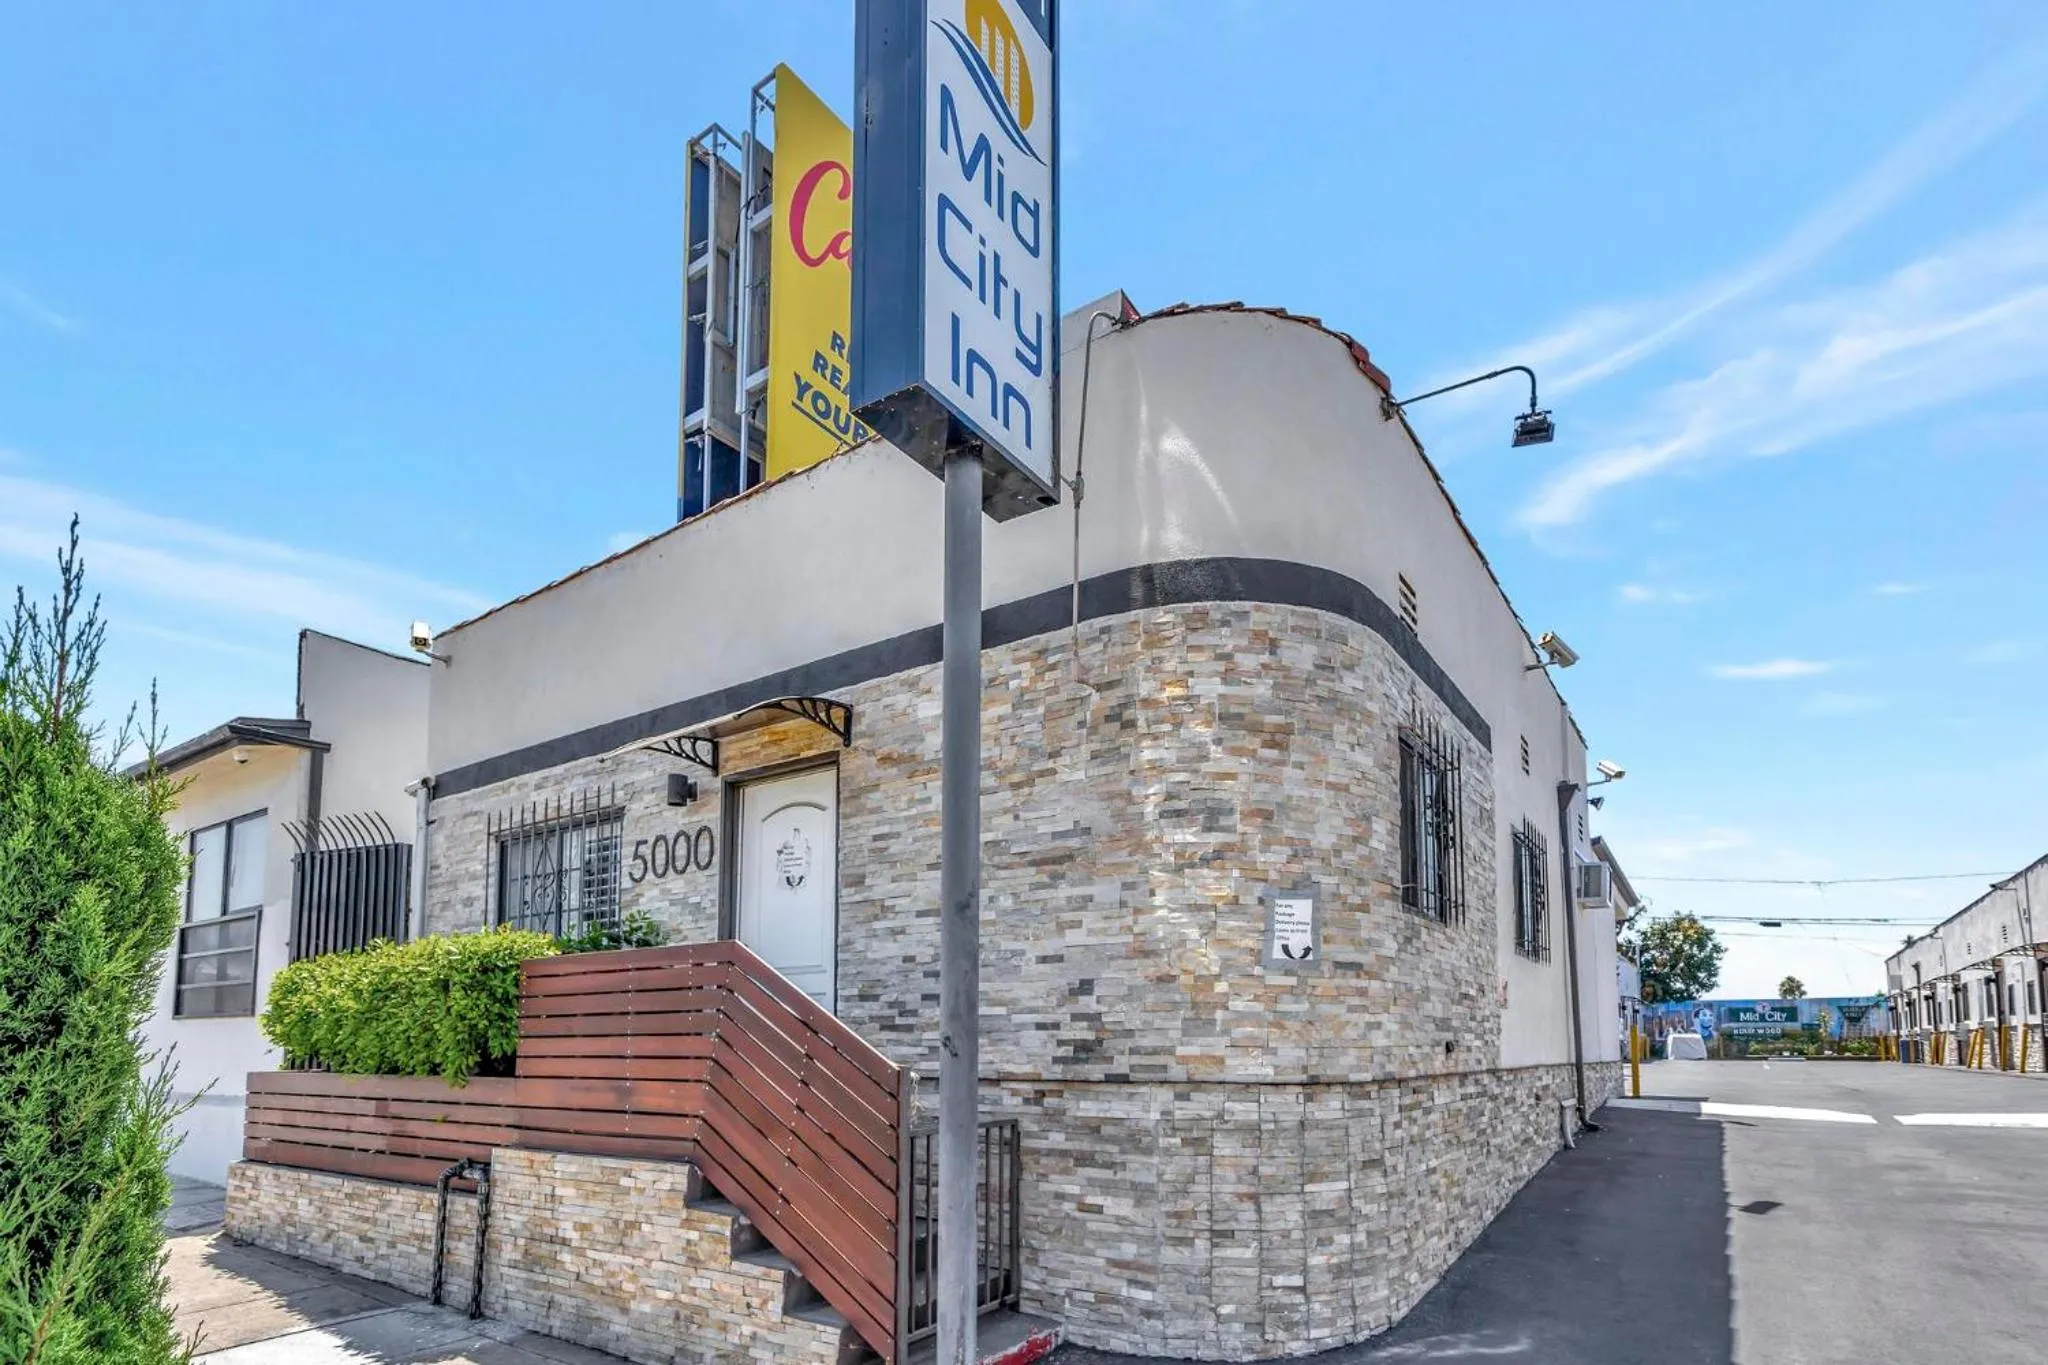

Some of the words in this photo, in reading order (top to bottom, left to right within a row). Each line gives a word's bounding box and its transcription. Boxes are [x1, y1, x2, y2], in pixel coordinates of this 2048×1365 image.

[940, 83, 1040, 258] Mid
[937, 193, 1042, 377] City
[951, 311, 1032, 450] Inn
[628, 825, 714, 883] 5000
[1765, 1010, 1787, 1021] City
